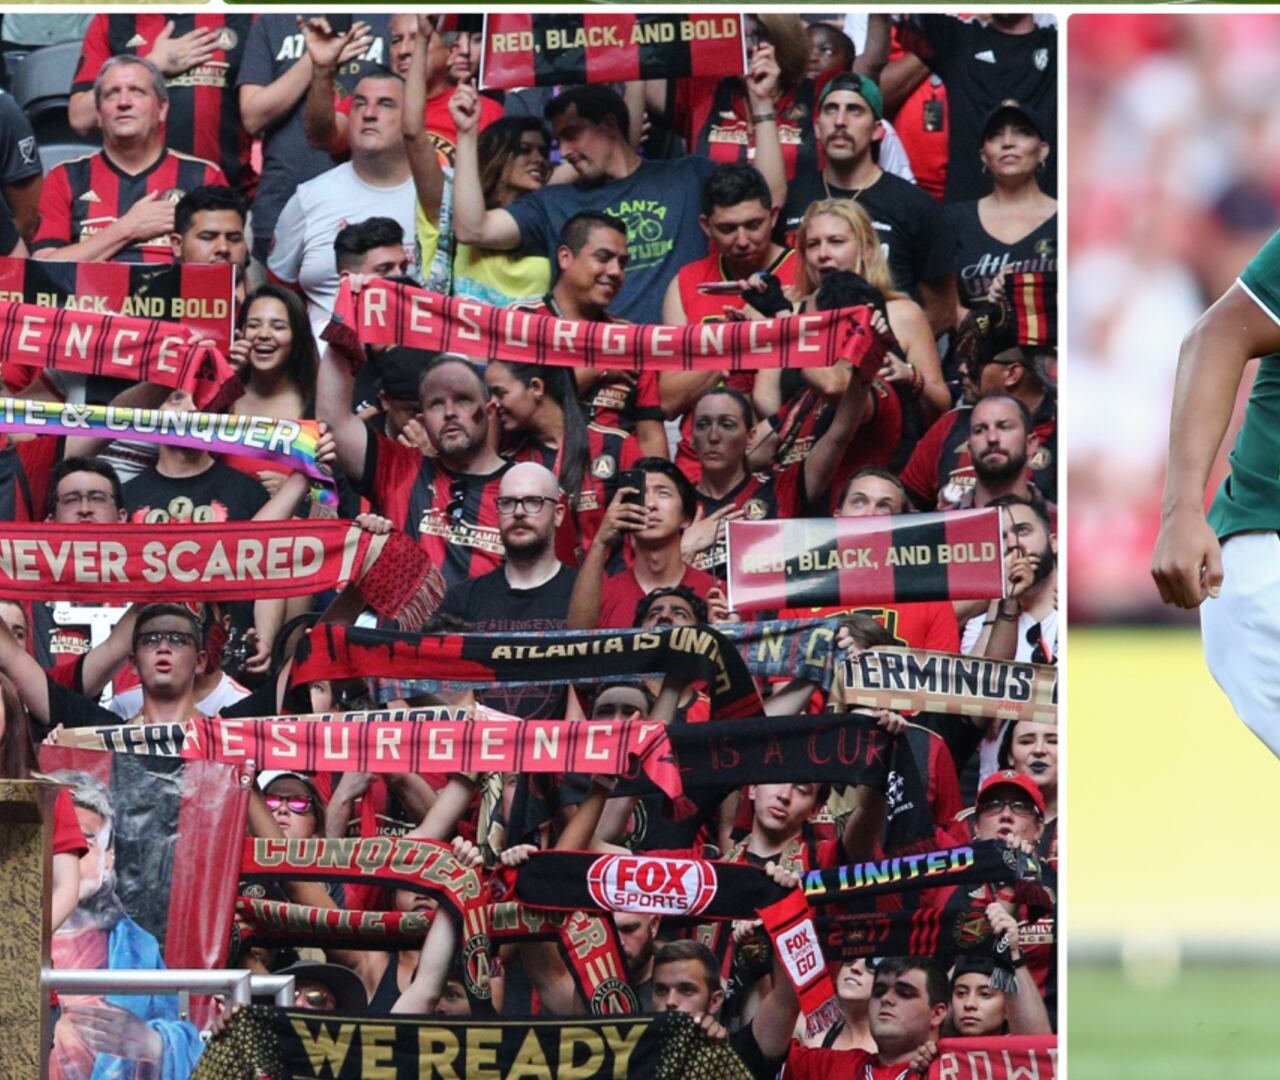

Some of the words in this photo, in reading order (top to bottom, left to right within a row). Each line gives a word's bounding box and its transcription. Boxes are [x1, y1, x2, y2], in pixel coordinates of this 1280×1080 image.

[492, 33, 541, 54] RED,
[545, 27, 623, 49] BLACK,
[630, 22, 676, 44] AND
[680, 18, 737, 41] BOLD
[121, 295, 165, 317] AND
[171, 297, 229, 320] BOLD
[364, 287, 823, 356] RESURGENCE
[61, 403, 93, 430] &
[105, 406, 303, 456] CONQUER
[141, 536, 325, 584] SCARED
[799, 547, 879, 571] BLACK,
[885, 544, 931, 567] AND
[937, 541, 997, 564] BOLD
[491, 637, 624, 660] ATLANTA
[632, 631, 662, 651] IS
[843, 651, 1035, 703] TERMINUS
[184, 720, 659, 760] ESURGENC
[253, 838, 482, 906] CONQUER
[619, 861, 694, 896] FOX
[838, 846, 974, 891] UNITED
[613, 893, 689, 910] SPORTS
[785, 929, 810, 953] FOX
[795, 954, 819, 977] GO
[288, 1019, 397, 1080] WE
[420, 1024, 648, 1080] READY
